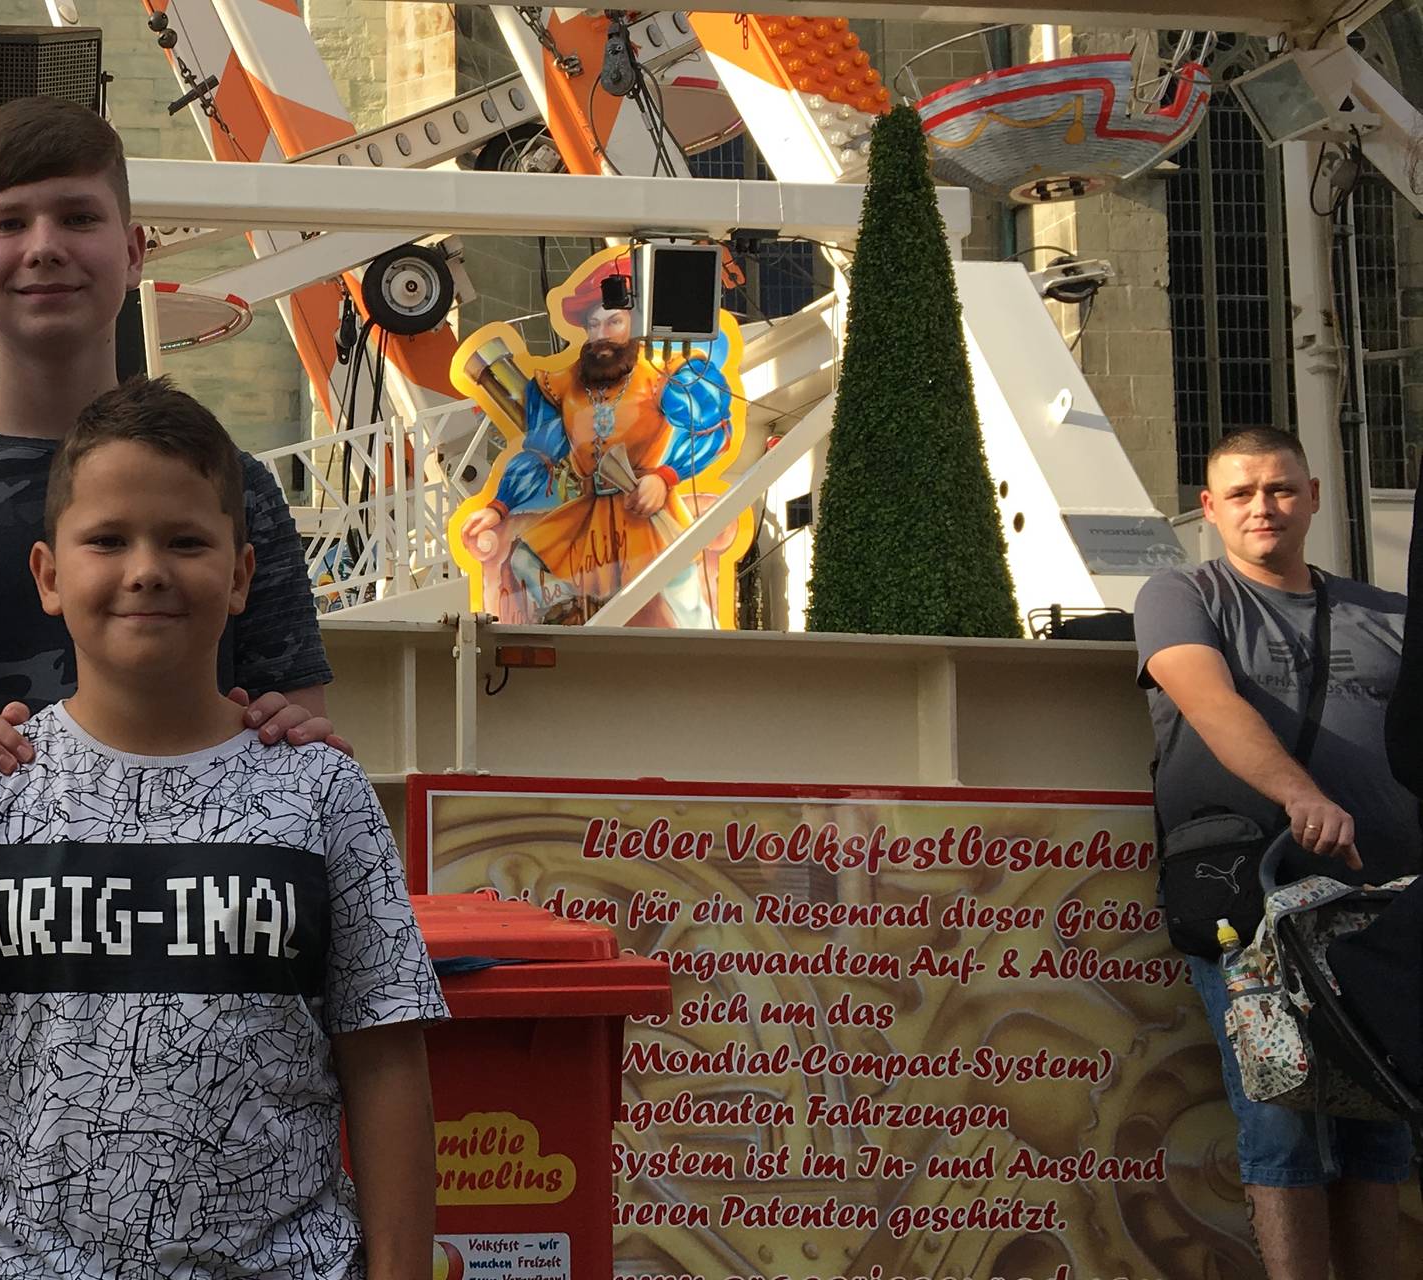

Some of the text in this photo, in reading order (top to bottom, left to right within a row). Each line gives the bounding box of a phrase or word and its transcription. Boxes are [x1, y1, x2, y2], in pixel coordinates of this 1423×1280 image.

[580, 816, 1154, 874] Lieber Volksfestbesucher
[628, 890, 681, 928] für
[692, 894, 743, 923] ein
[755, 895, 930, 930] Riesenrad
[942, 897, 1045, 932] dieser
[1056, 900, 1161, 938] Größe
[908, 946, 985, 984] Auf-
[998, 948, 1020, 978] &
[681, 992, 894, 1029] sich um das
[806, 1095, 1008, 1136] Fahrzeugen
[613, 1143, 1164, 1182] System ist im In- und Ausland
[721, 1196, 877, 1229] Patenten
[889, 1198, 1066, 1238] geschützt.
[468, 1239, 519, 1253] Volksfest
[539, 1238, 560, 1250] wir
[469, 1255, 562, 1269] machen Freizeit
